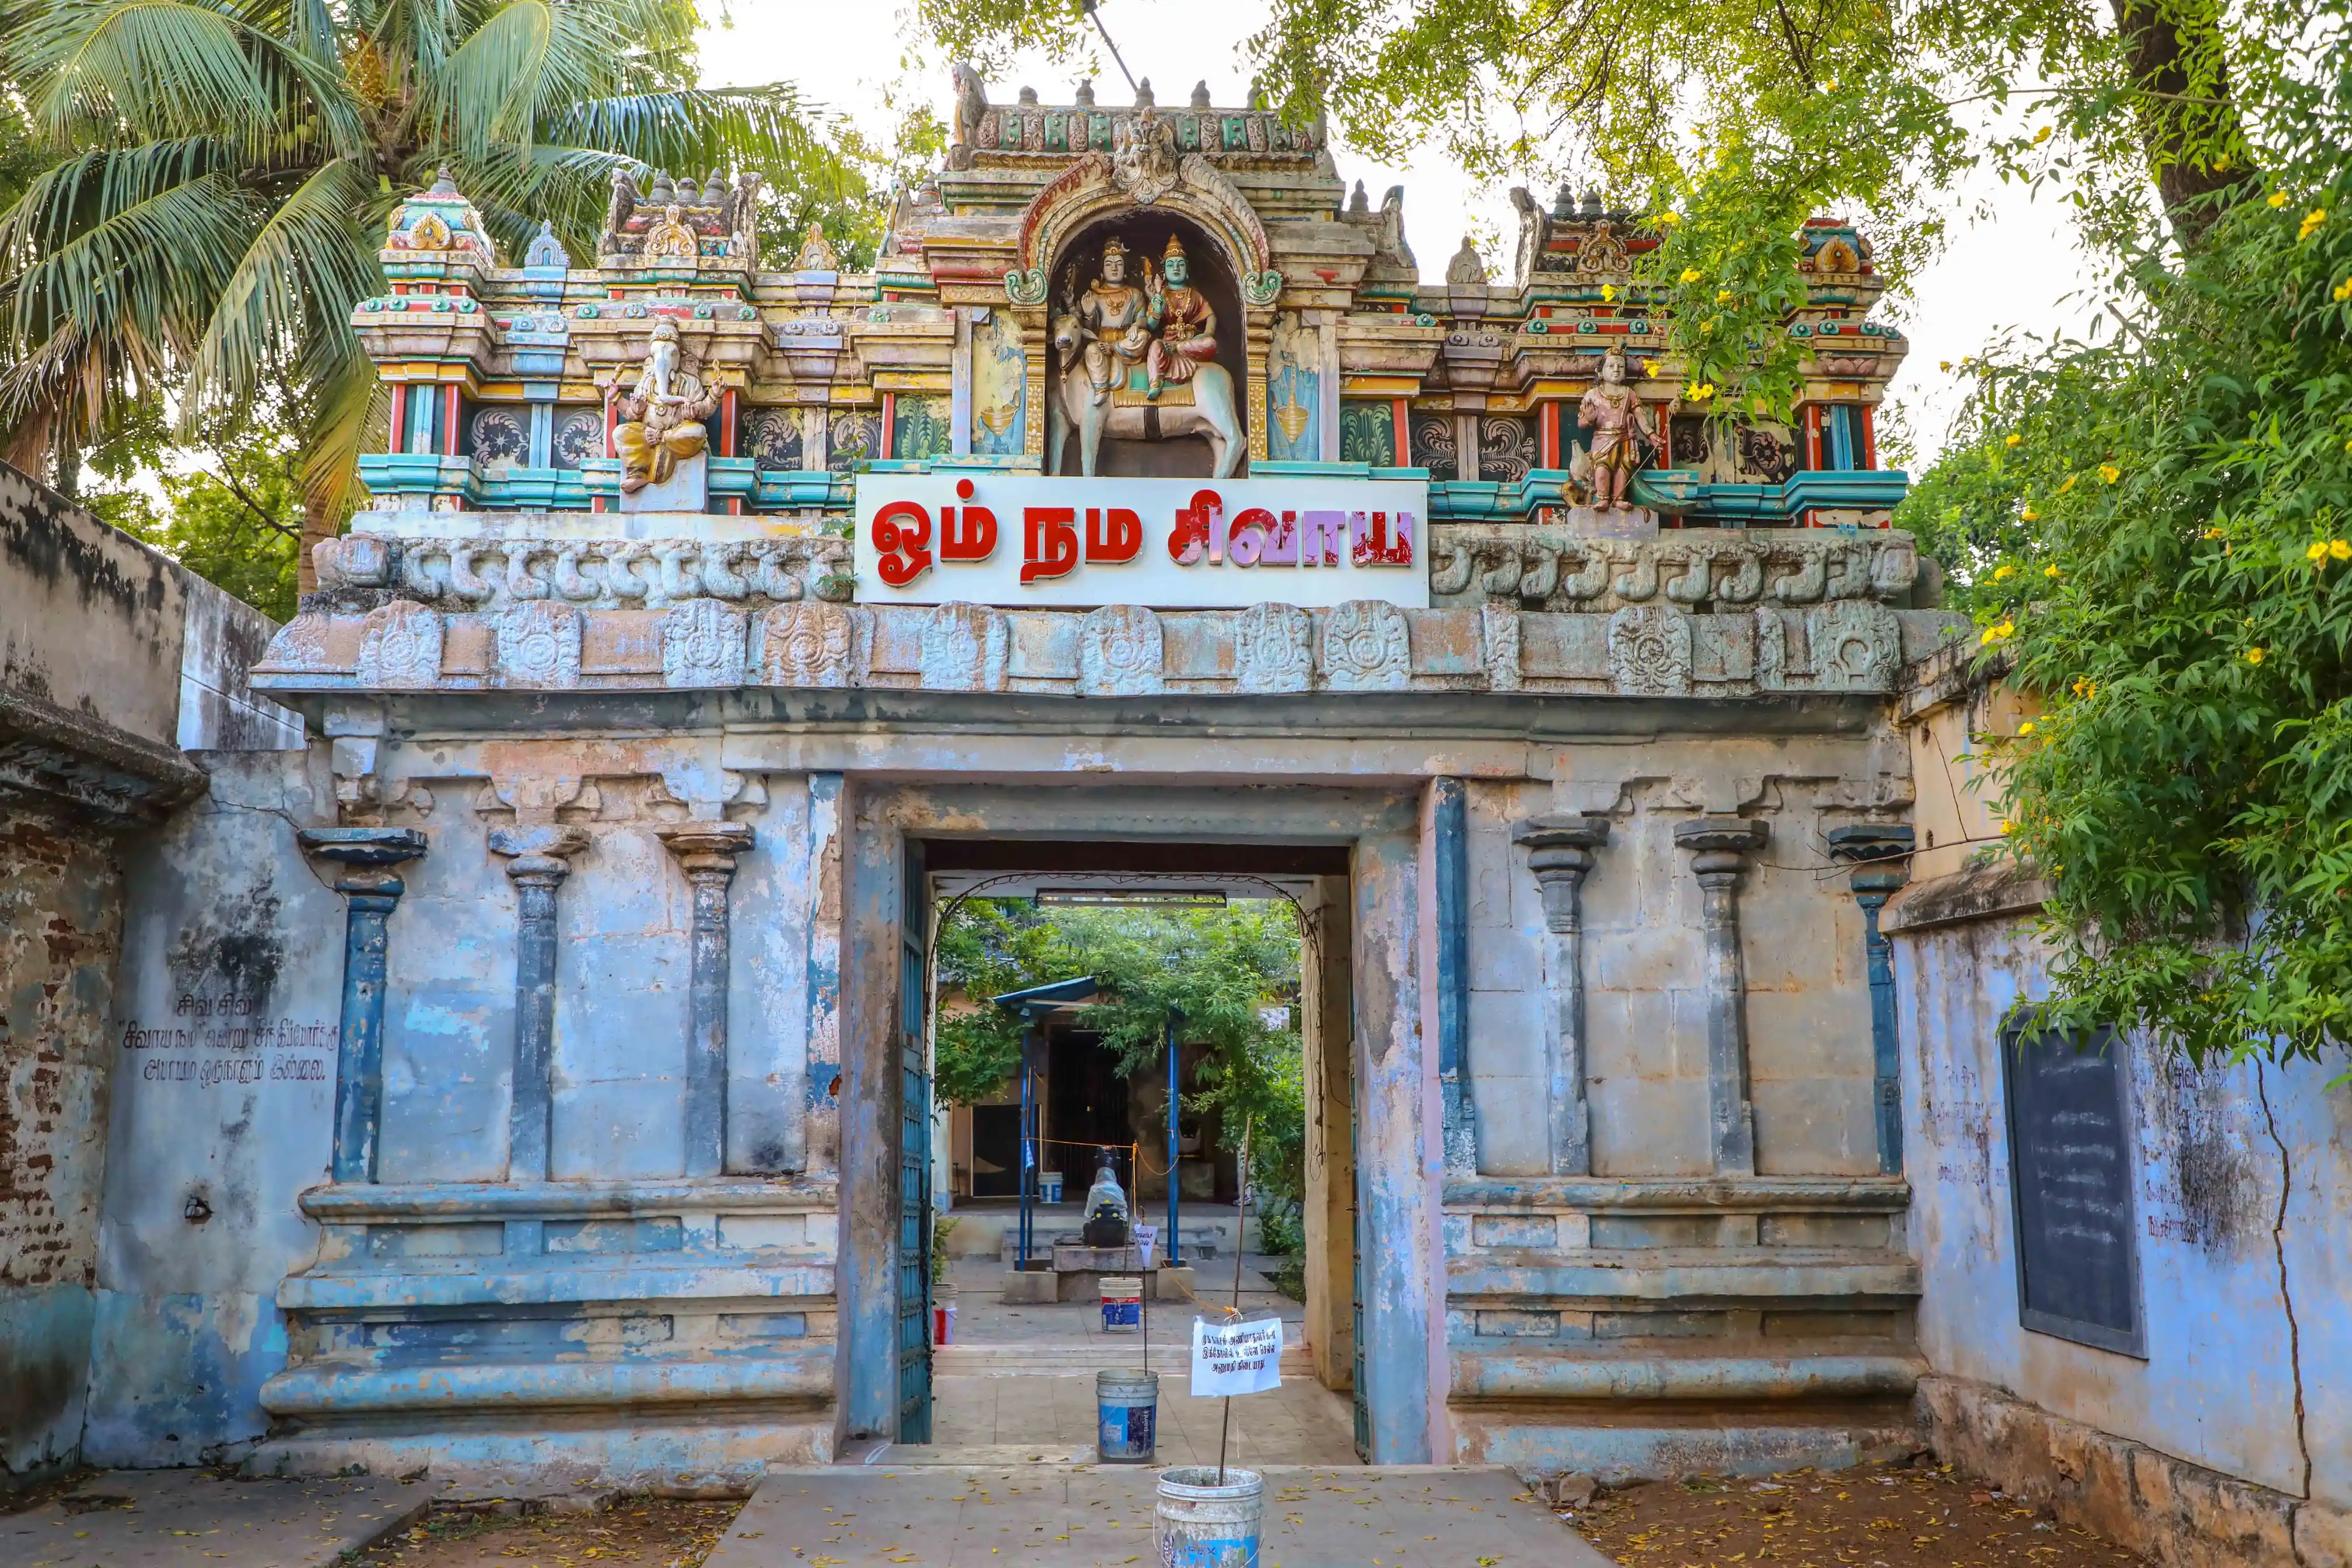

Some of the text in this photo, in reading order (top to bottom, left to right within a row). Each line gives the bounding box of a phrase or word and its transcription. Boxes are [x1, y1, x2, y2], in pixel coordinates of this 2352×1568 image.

[872, 478, 1413, 588] ஓம் நம சிவாய
[177, 993, 212, 1016] சிவ
